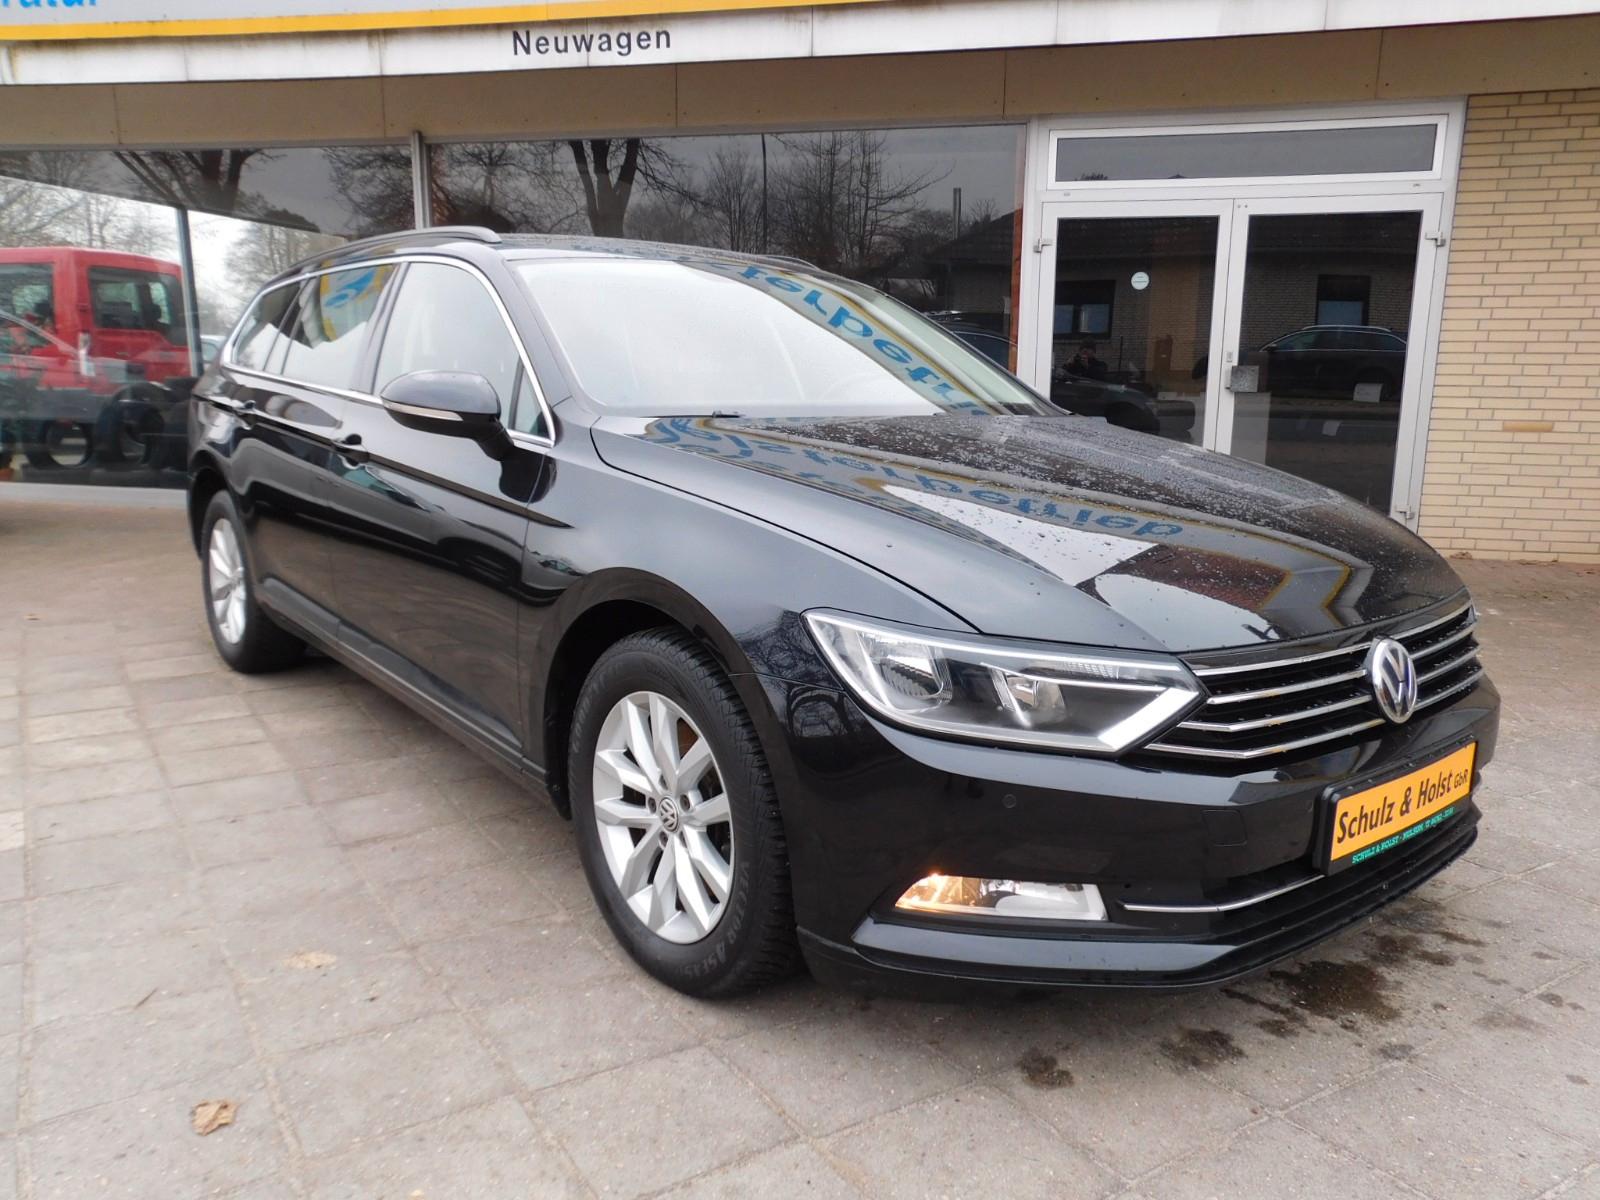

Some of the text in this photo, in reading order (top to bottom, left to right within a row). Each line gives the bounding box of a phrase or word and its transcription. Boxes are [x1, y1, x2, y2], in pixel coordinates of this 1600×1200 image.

[512, 29, 671, 56] Neuwagen
[1337, 796, 1395, 844] Schulz
[1400, 786, 1412, 817] &
[1416, 771, 1453, 809] Holst
[1454, 769, 1469, 788] GbR
